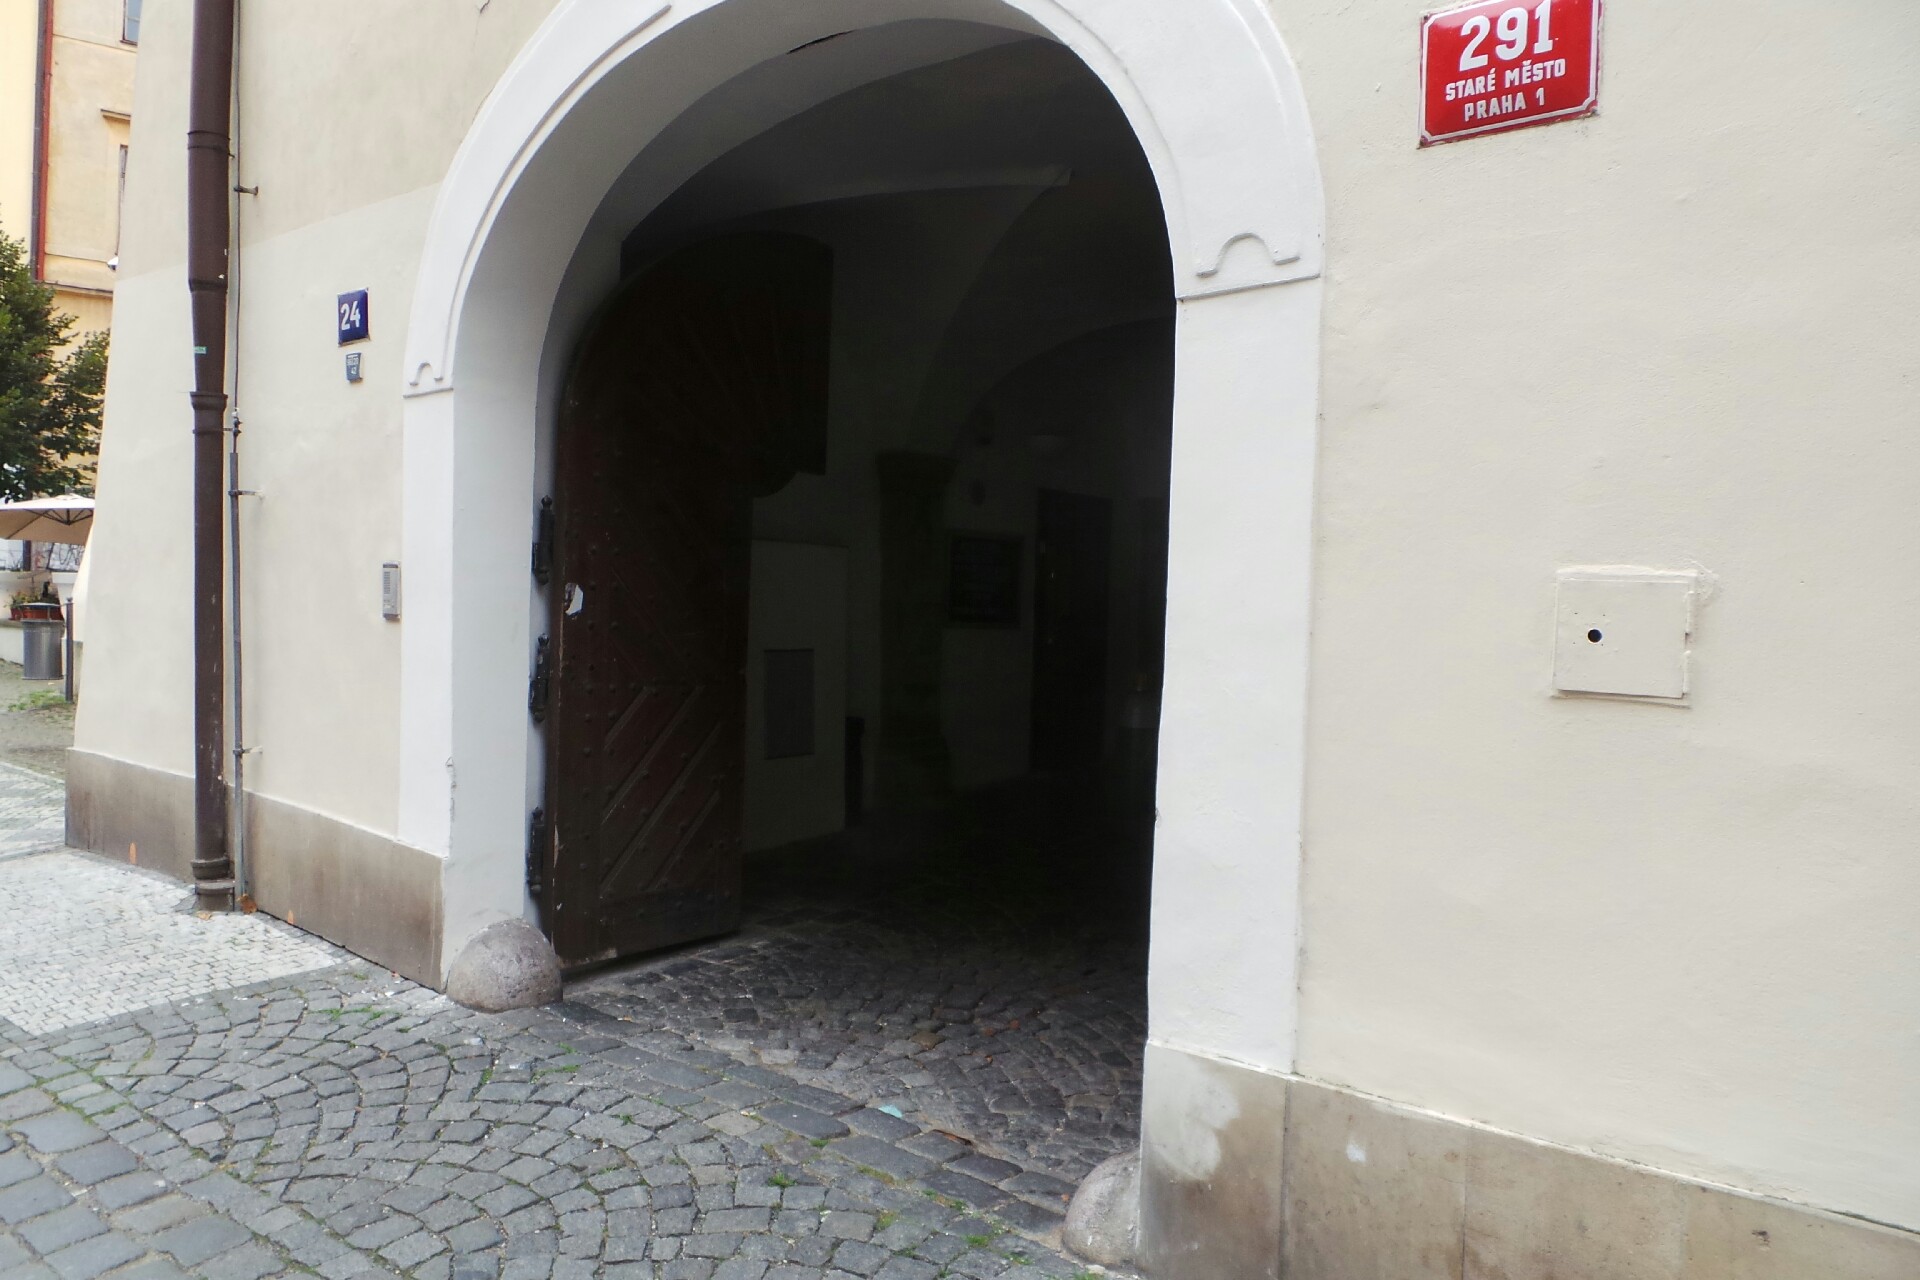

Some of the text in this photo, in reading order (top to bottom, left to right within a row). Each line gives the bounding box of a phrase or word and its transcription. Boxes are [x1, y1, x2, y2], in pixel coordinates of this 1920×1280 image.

[1459, 0, 1553, 71] 291
[1445, 59, 1566, 101] STARÉ MĚSTO
[1464, 87, 1545, 122] PRAHA 1
[340, 300, 361, 331] 24
